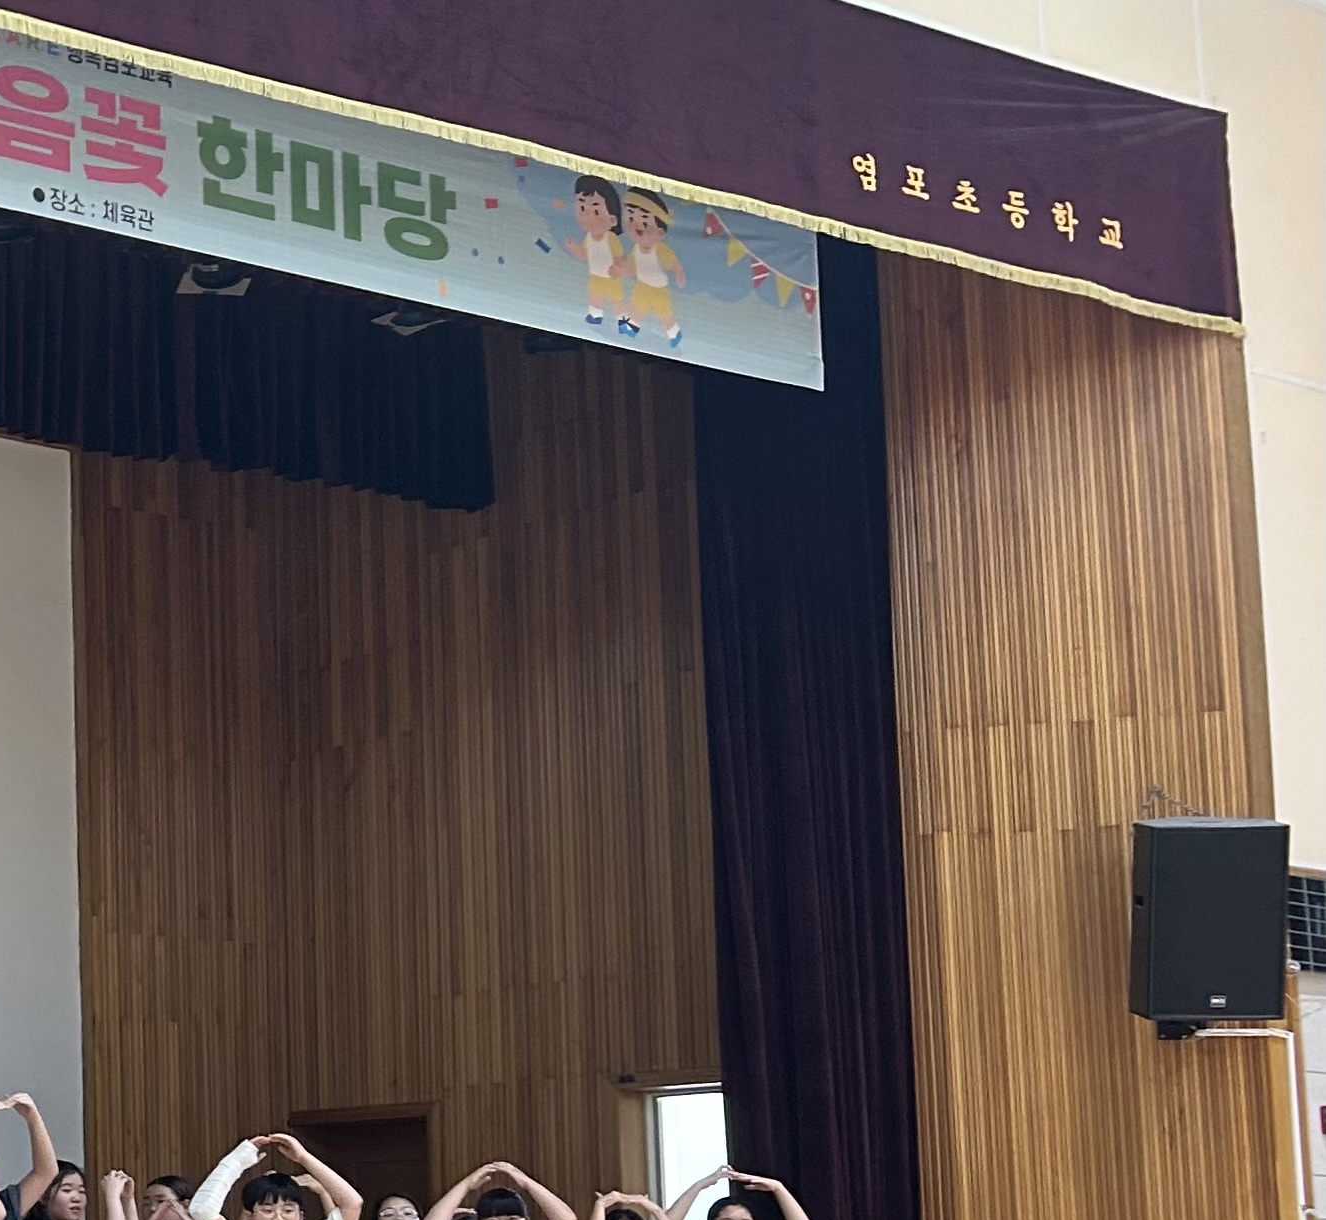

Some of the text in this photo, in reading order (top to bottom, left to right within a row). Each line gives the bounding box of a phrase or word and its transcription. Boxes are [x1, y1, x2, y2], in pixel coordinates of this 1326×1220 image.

[50, 187, 85, 216] 장소
[103, 200, 155, 232] 체육관
[197, 115, 457, 260] 한마당
